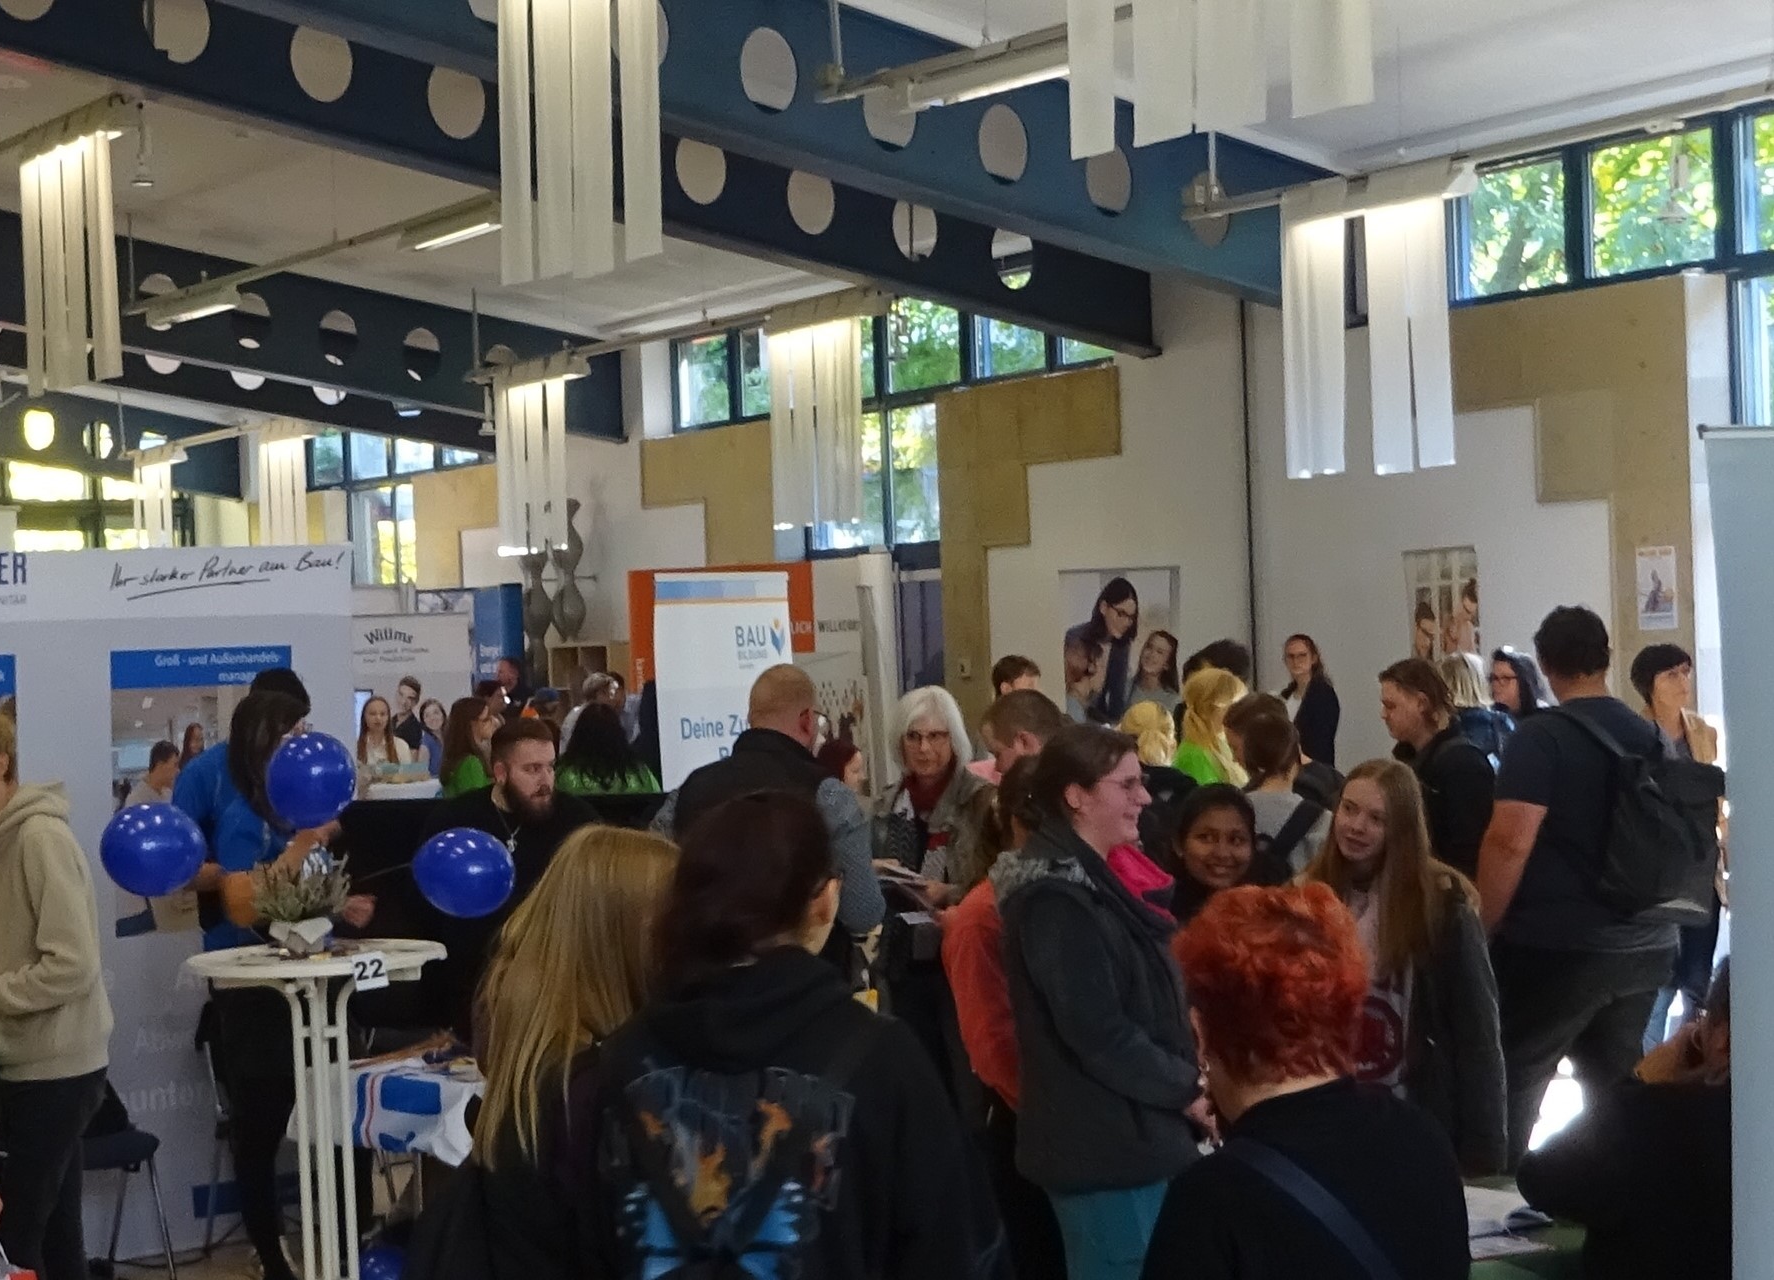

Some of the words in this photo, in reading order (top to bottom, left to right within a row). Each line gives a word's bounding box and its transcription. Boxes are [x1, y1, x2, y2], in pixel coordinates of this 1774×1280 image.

[734, 625, 767, 647] BAU
[680, 717, 724, 740] Deine
[354, 958, 385, 981] 22
